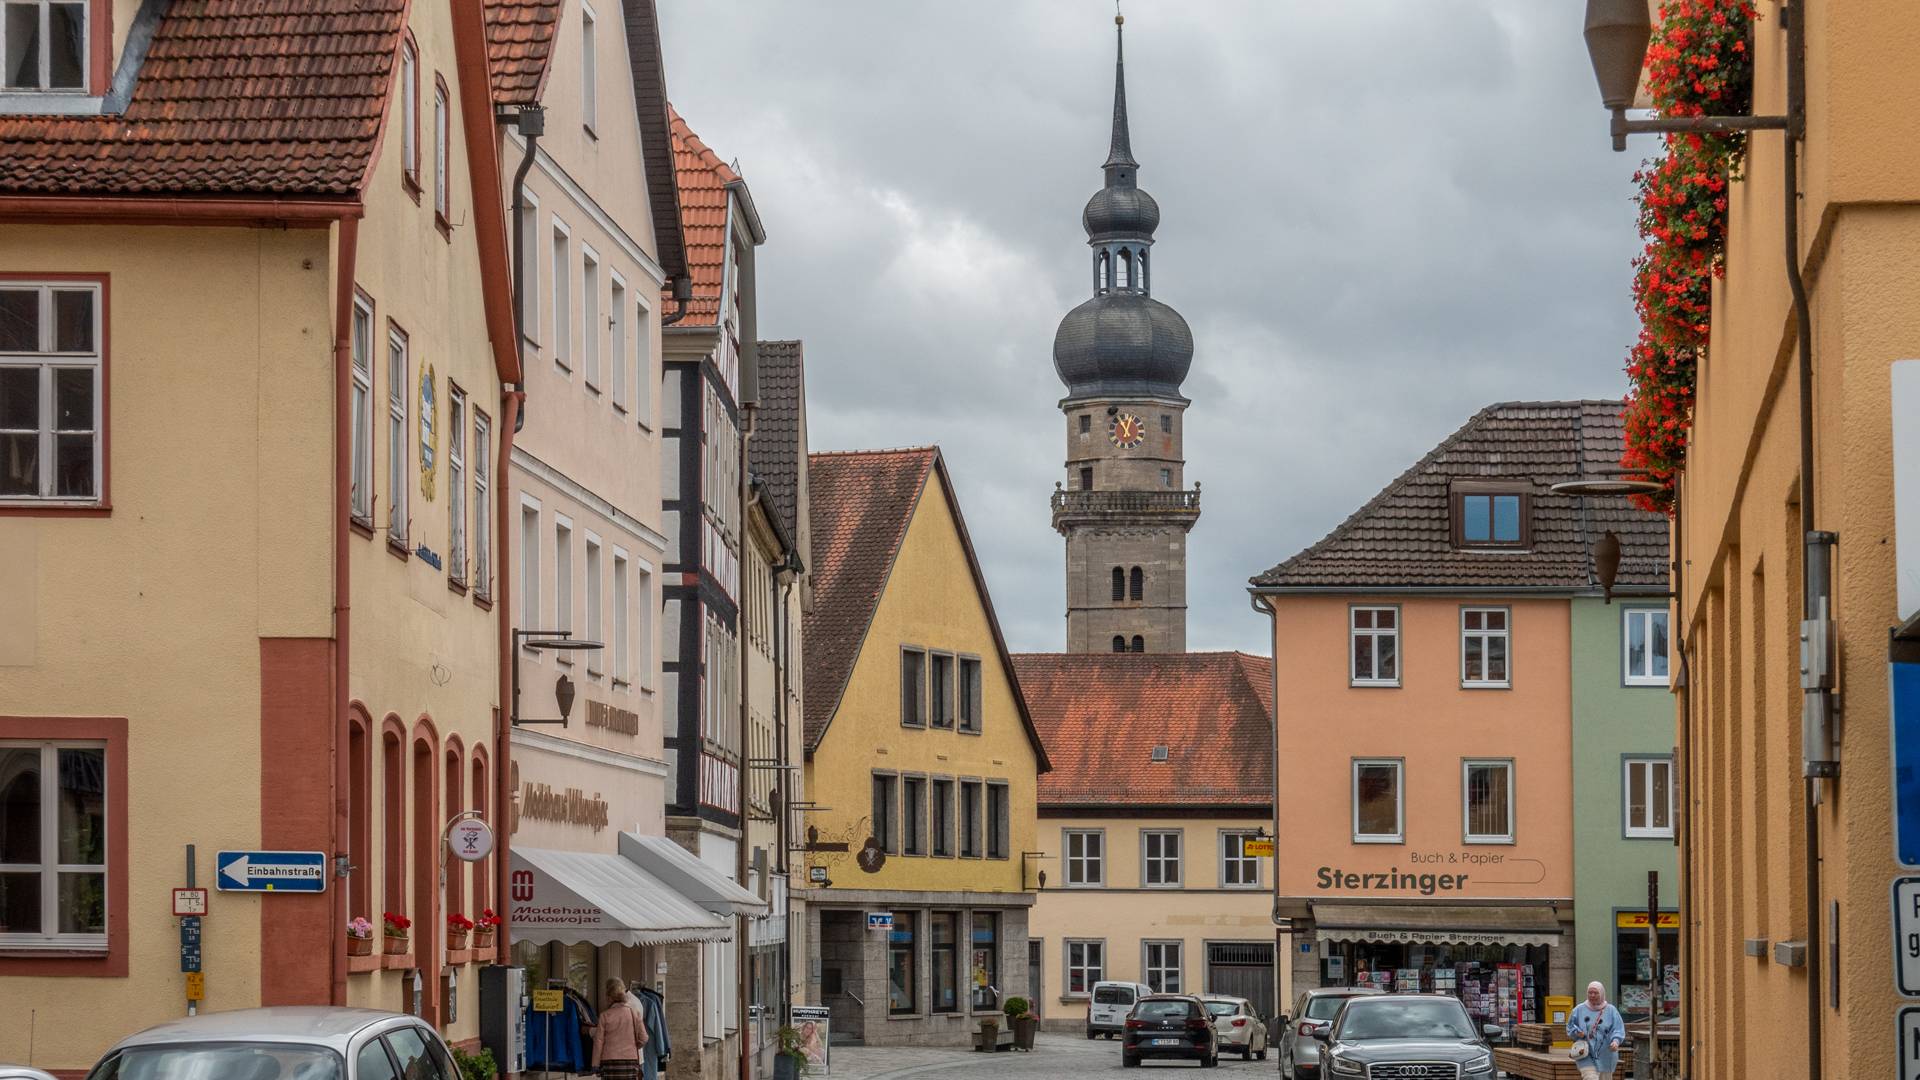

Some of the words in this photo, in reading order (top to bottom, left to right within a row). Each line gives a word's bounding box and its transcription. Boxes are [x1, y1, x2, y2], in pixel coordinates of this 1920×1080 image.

[1411, 852, 1444, 864] Buch
[1449, 852, 1457, 864] &
[1462, 852, 1505, 866] Papier
[247, 866, 321, 876] Einbahnstraße
[1316, 866, 1468, 896] Sterzinger
[513, 906, 601, 914] Modehaus
[511, 915, 601, 924] Wukowojac
[1368, 932, 1396, 940] Buch
[1400, 932, 1408, 940] &
[1411, 933, 1445, 941] Papier
[1449, 934, 1505, 942] Sterzinger
